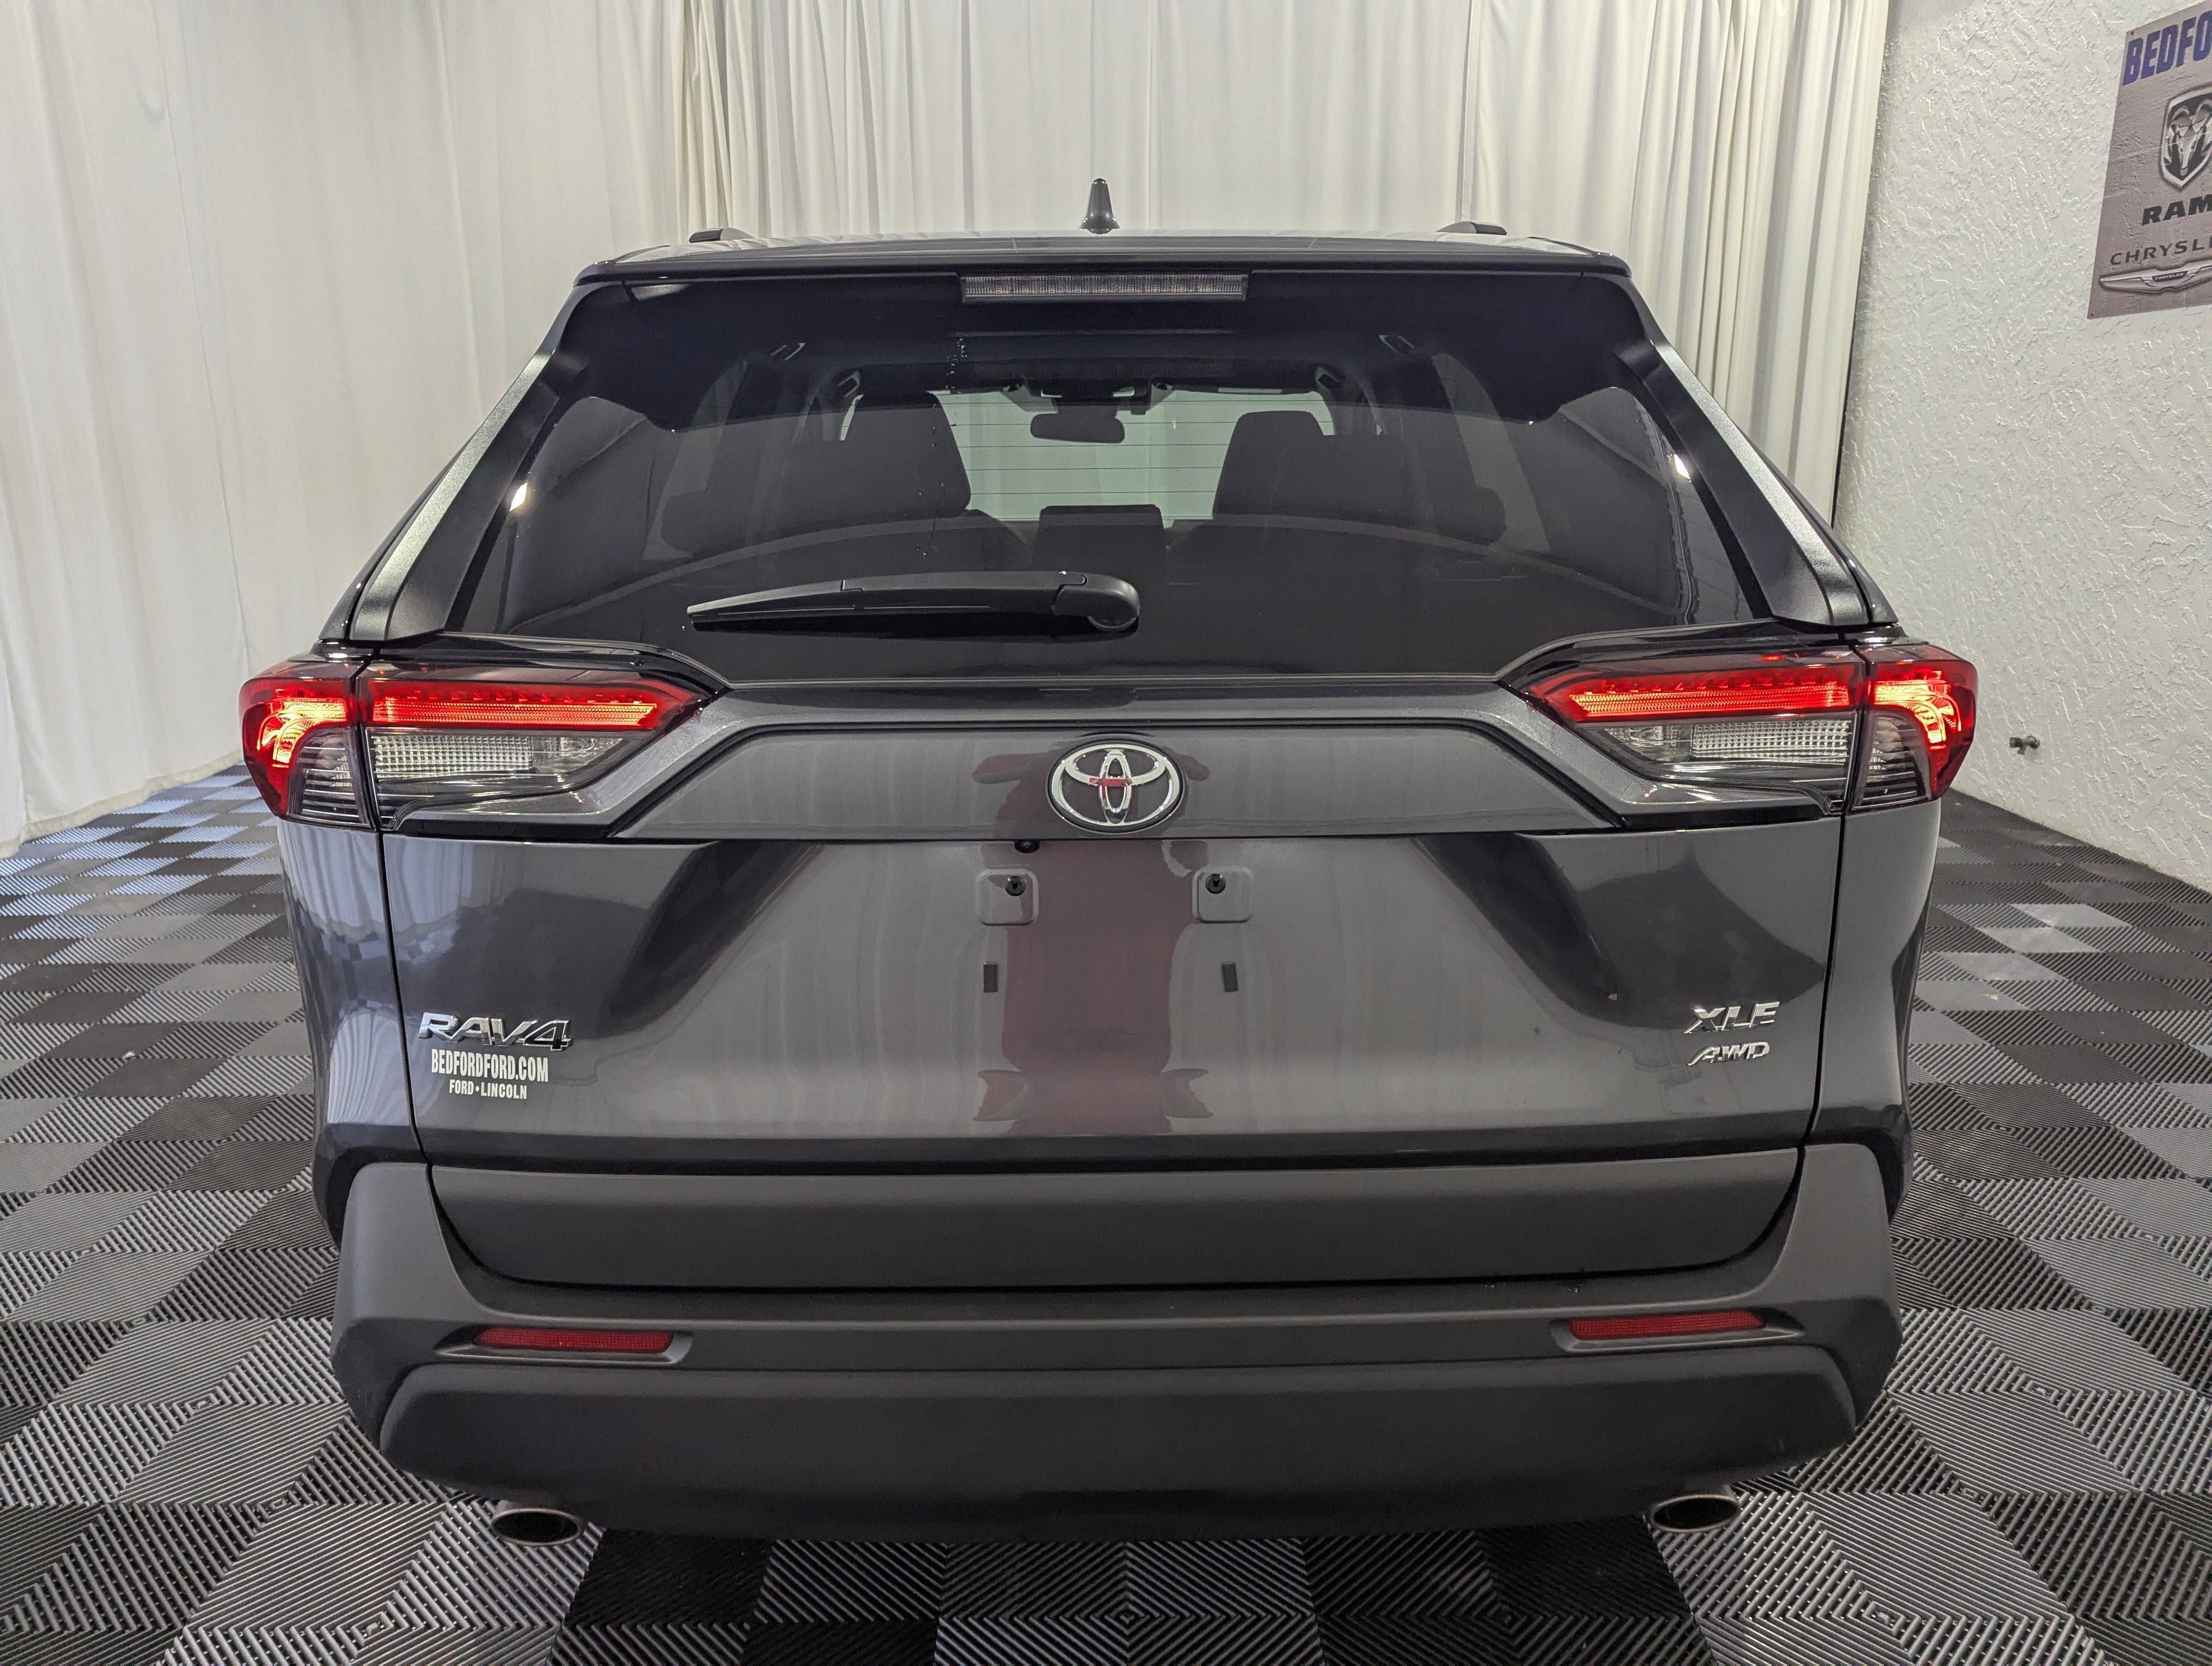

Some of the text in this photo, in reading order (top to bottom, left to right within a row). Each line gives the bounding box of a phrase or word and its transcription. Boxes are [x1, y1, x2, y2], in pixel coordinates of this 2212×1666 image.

[2142, 194, 2212, 226] RAM
[2110, 235, 2212, 265] CHRYSL
[418, 1012, 573, 1051] RAV4
[1683, 1001, 1780, 1034] XLE
[431, 1048, 549, 1082] BEDFORDFORD.COM
[1687, 1042, 1770, 1066] AWD
